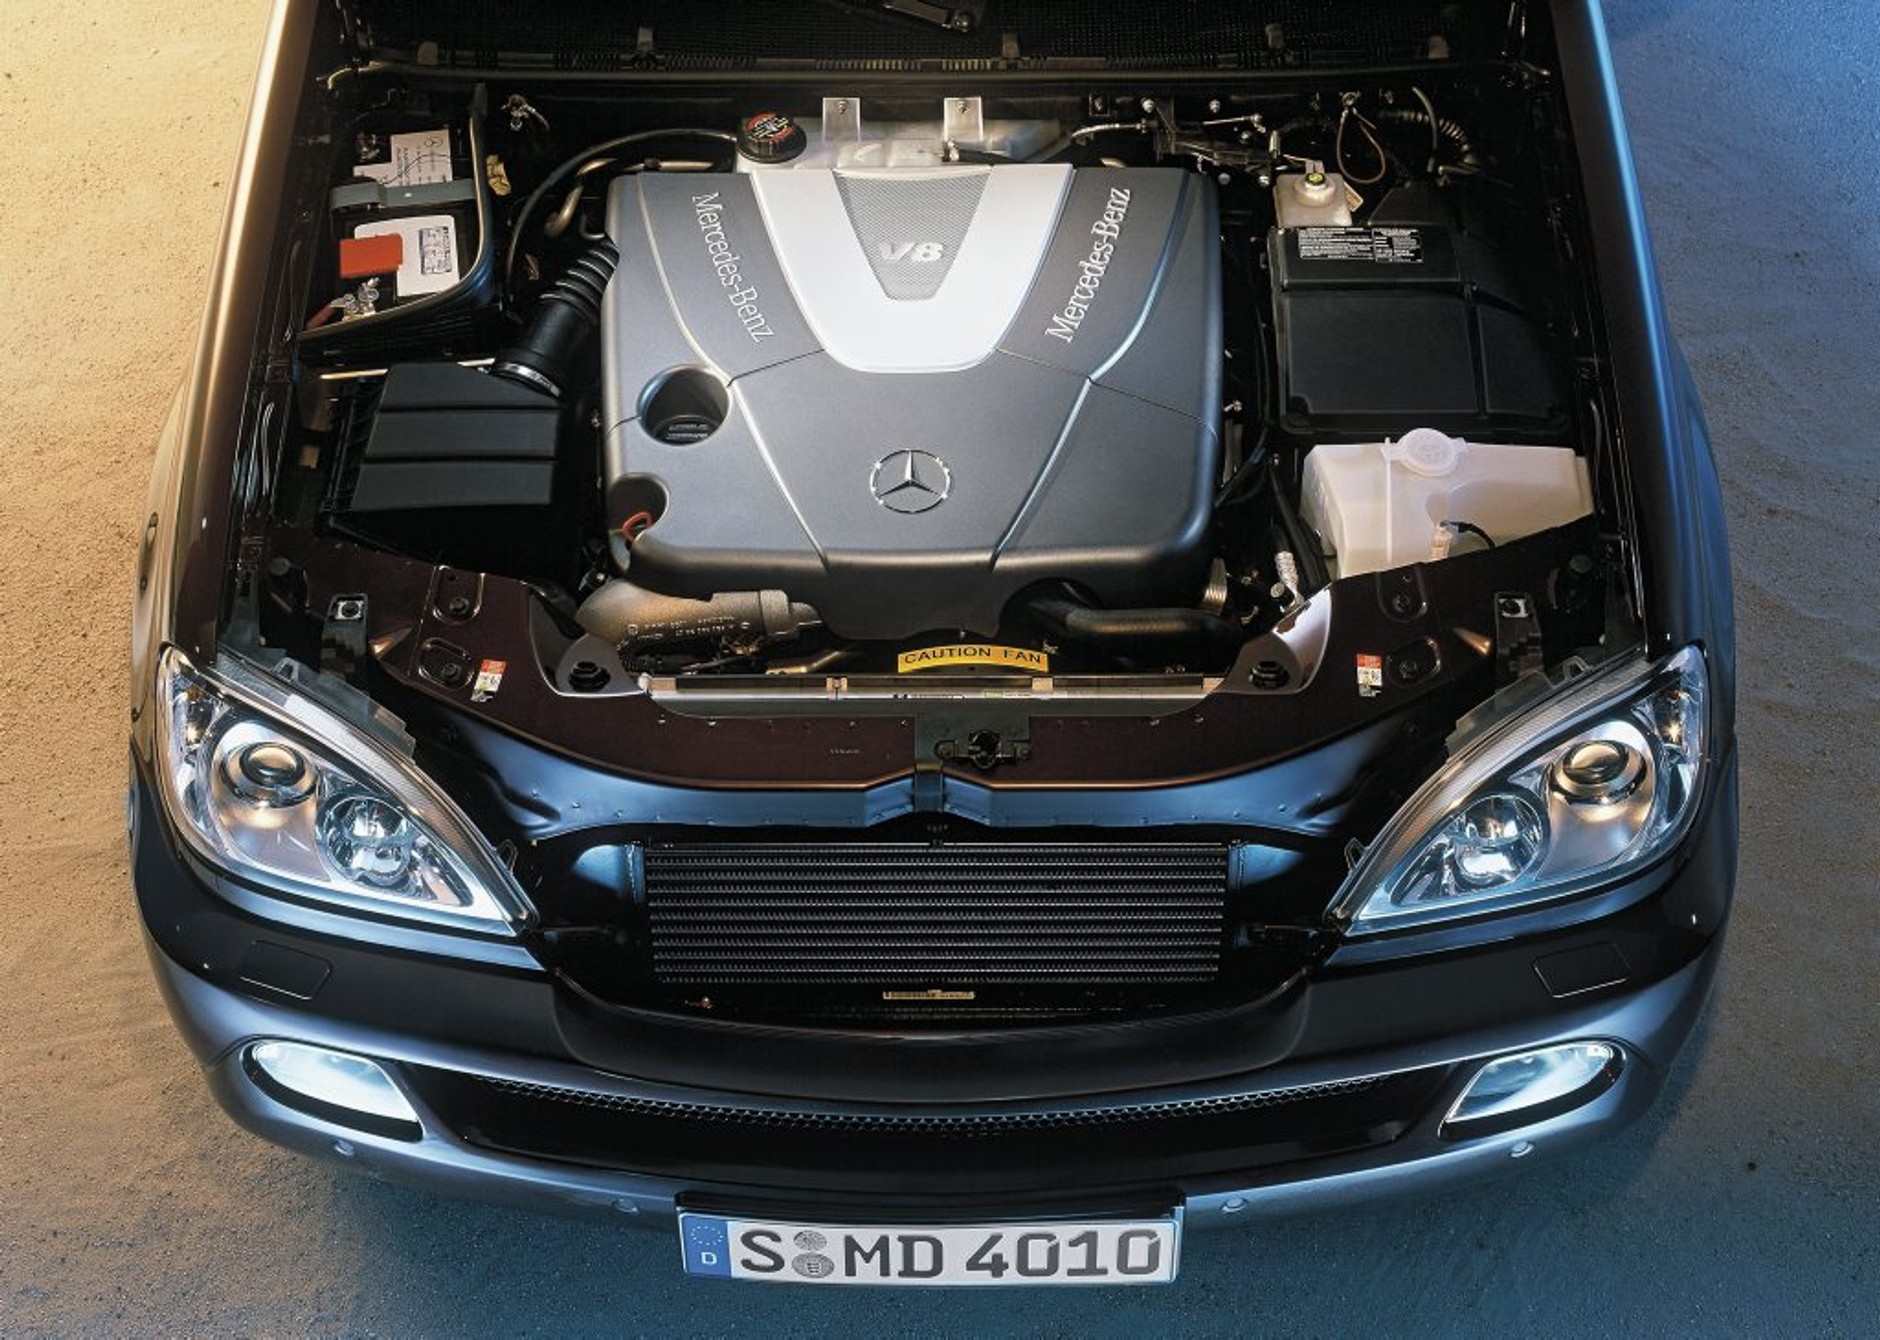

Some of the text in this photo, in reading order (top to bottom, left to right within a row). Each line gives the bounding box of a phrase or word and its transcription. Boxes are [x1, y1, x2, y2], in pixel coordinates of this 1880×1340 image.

[692, 191, 775, 343] Mercedes-Benz
[880, 240, 943, 264] V8
[1045, 187, 1131, 344] Mercedes-Benz
[905, 647, 991, 664] CAUTION
[701, 1251, 717, 1265] D
[740, 1229, 1162, 1278] S MD 4010
